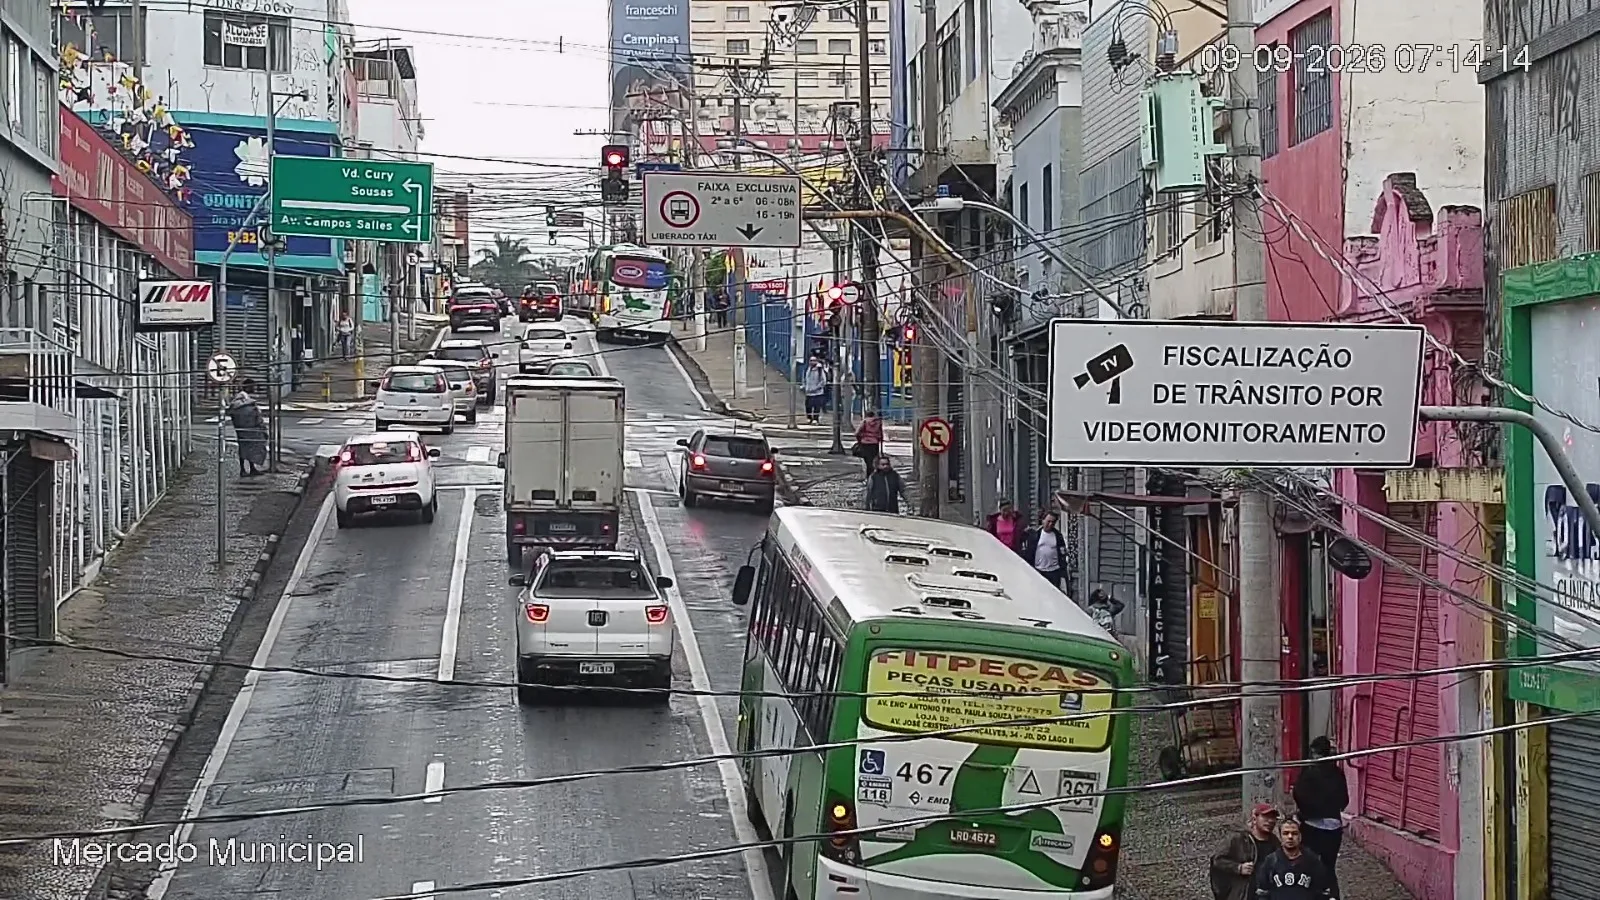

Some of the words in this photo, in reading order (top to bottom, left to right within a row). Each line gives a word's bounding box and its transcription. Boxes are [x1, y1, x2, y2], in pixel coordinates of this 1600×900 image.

[625, 4, 677, 15] franceschi
[622, 33, 680, 47] Campinas
[342, 167, 360, 179] Vd.
[365, 169, 394, 182] Cury
[351, 186, 394, 198] Sousas
[697, 182, 731, 192] FAIXA
[736, 183, 797, 194] EXCLUSIVA
[755, 197, 768, 206] 06
[777, 197, 795, 207] 08h
[756, 210, 768, 219] 16
[779, 211, 795, 220] 19h
[281, 215, 299, 226] Av.
[304, 217, 352, 230] Campos
[356, 220, 393, 231] Salles
[651, 232, 696, 241] LIBERADO
[698, 232, 717, 241] TÁXI
[1163, 343, 1352, 373] FISCALIZAÇÃO
[1153, 384, 1187, 405] DE
[1195, 380, 1323, 406] TRÂNSITO
[1330, 386, 1384, 407] POR
[1083, 421, 1386, 444] VIDEOMONITORAMENTO
[877, 651, 1100, 687] FITPEÇAS
[887, 670, 954, 688] PEÇAS
[961, 679, 1043, 693] USADAS
[877, 699, 888, 707] AV.
[909, 703, 941, 712] ANTONIO
[965, 708, 987, 718] PAULA
[916, 713, 937, 721] LOJA
[903, 719, 920, 728] JOSÉ
[1037, 733, 1047, 741] DO
[1049, 734, 1068, 744] LAGO
[896, 762, 954, 787] 467
[861, 789, 887, 800] 118
